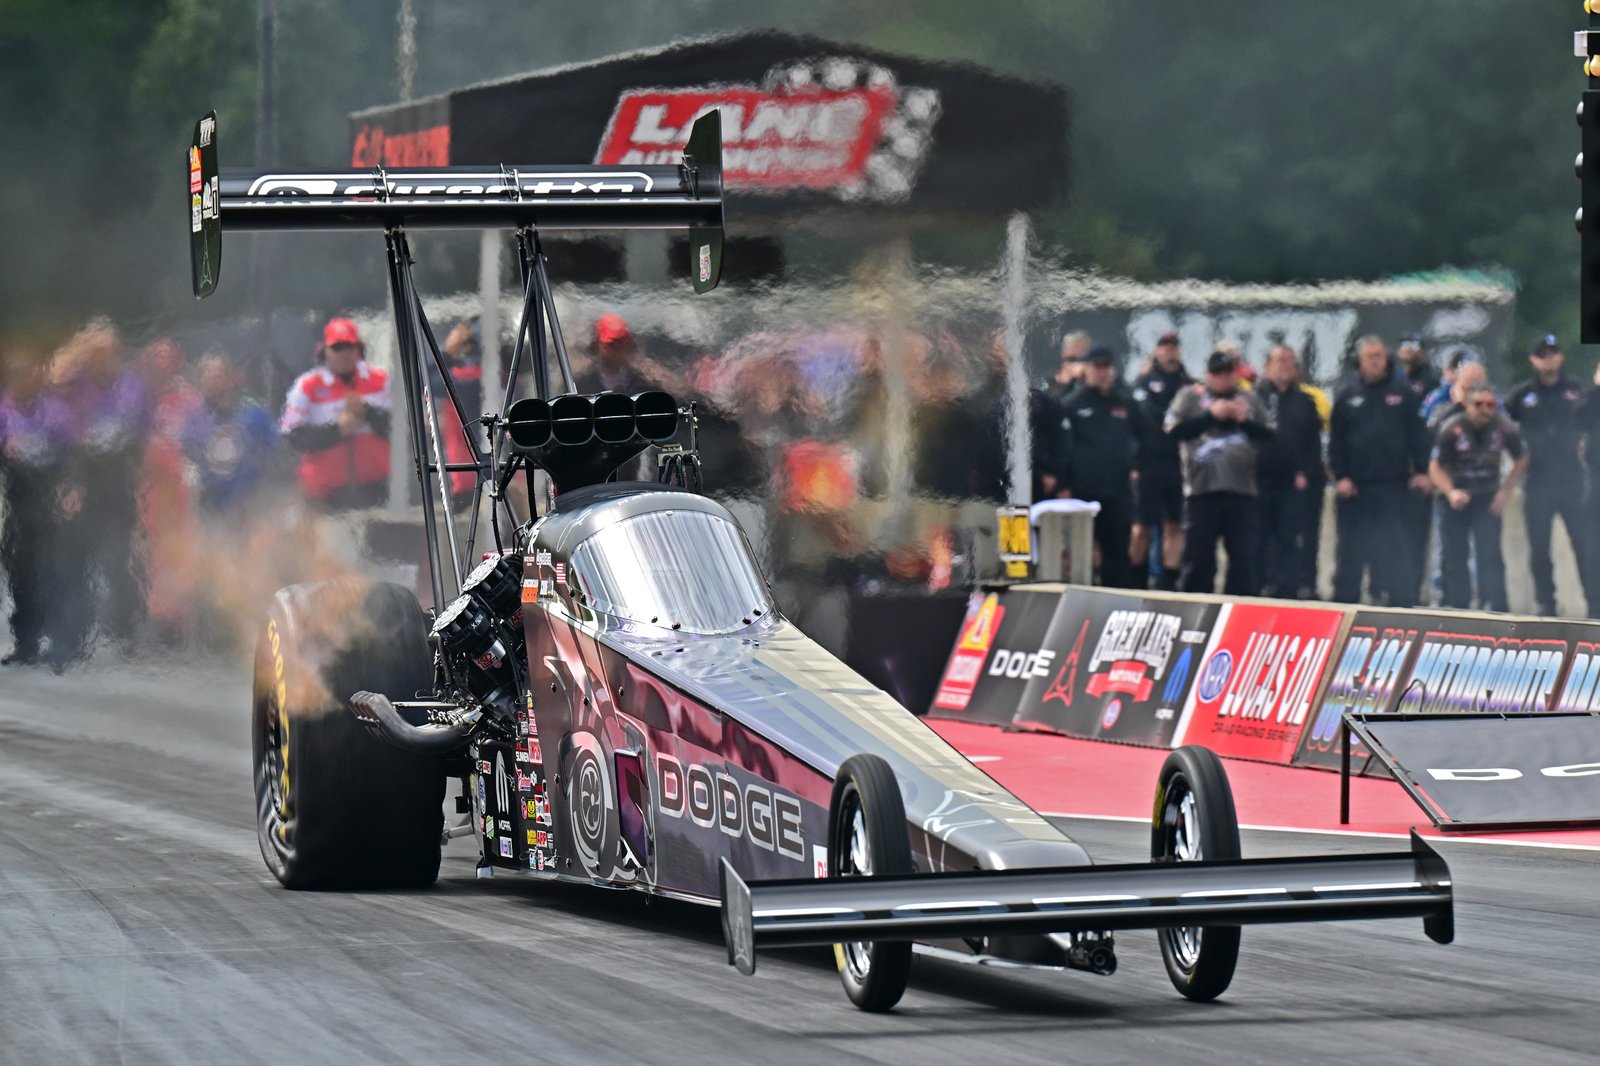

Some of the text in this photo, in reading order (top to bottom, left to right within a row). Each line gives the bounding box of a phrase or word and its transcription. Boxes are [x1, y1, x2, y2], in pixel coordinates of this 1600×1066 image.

[1218, 631, 1331, 725] LUCAS OIL
[656, 752, 804, 862] DODGE
